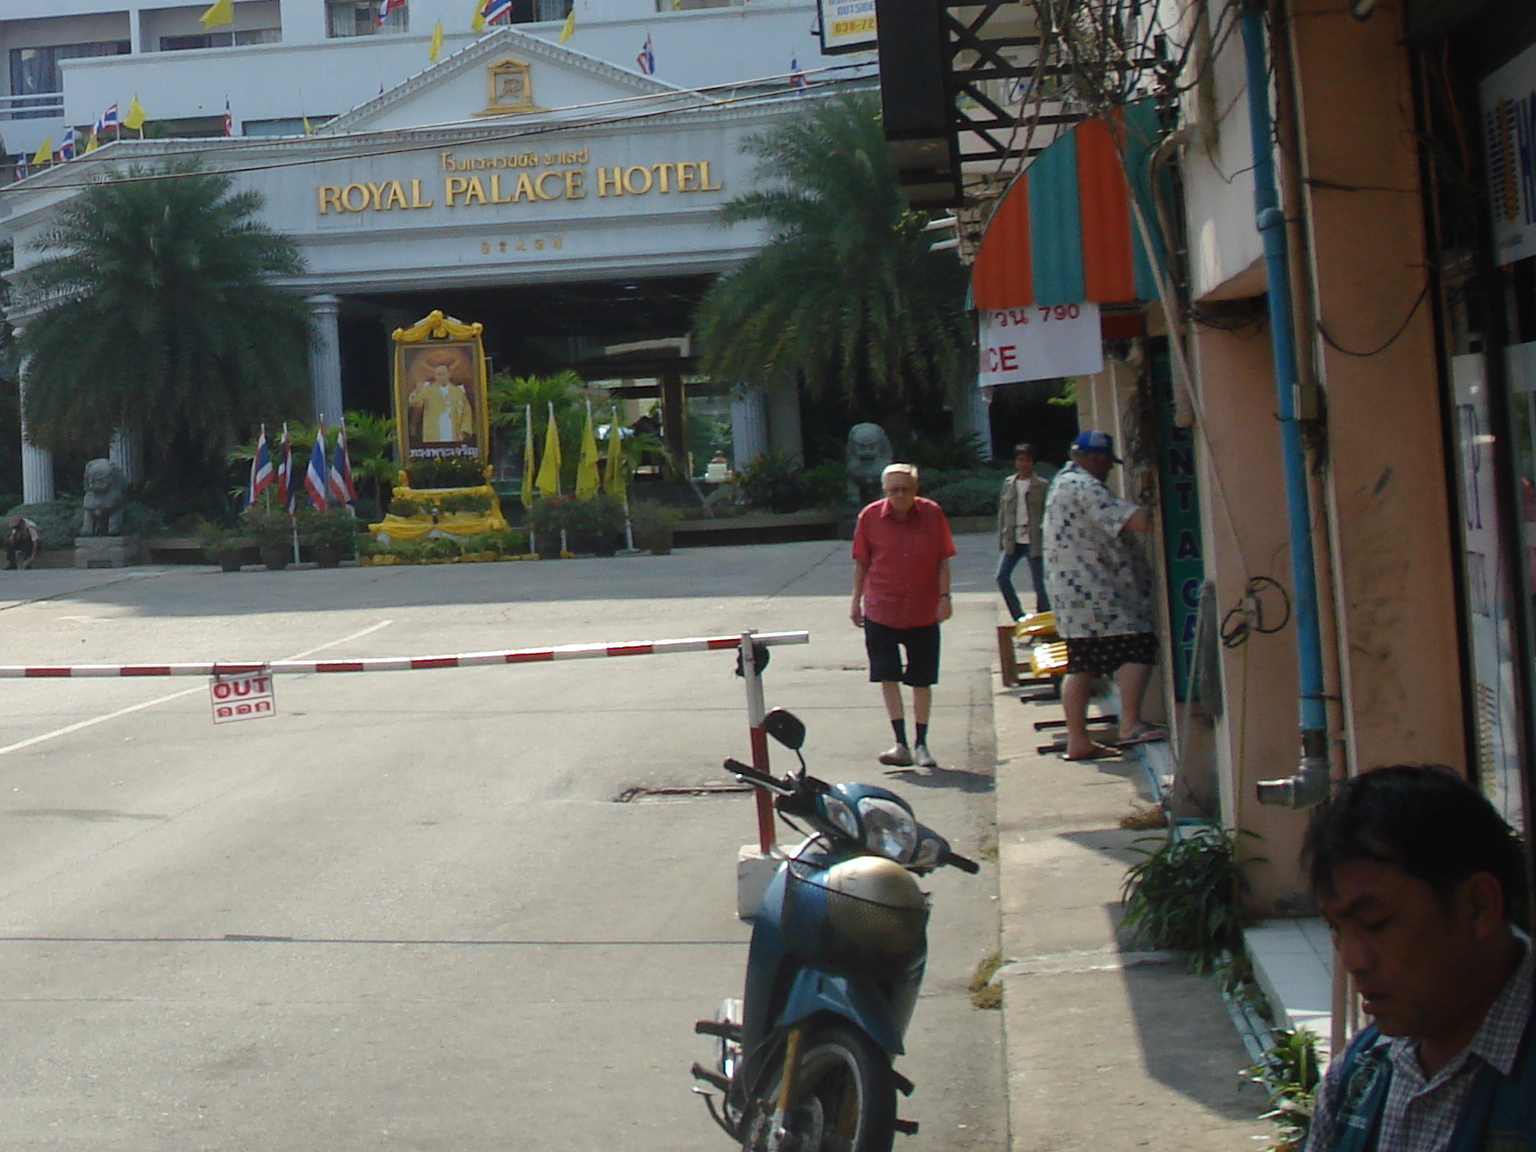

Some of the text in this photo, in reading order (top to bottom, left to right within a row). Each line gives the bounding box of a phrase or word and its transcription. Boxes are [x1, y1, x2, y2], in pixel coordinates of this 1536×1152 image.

[317, 161, 722, 214] ROYAL PALACE HOTEL
[1175, 529, 1201, 560] A
[213, 677, 269, 699] OUT
[216, 701, 271, 718] ออก
